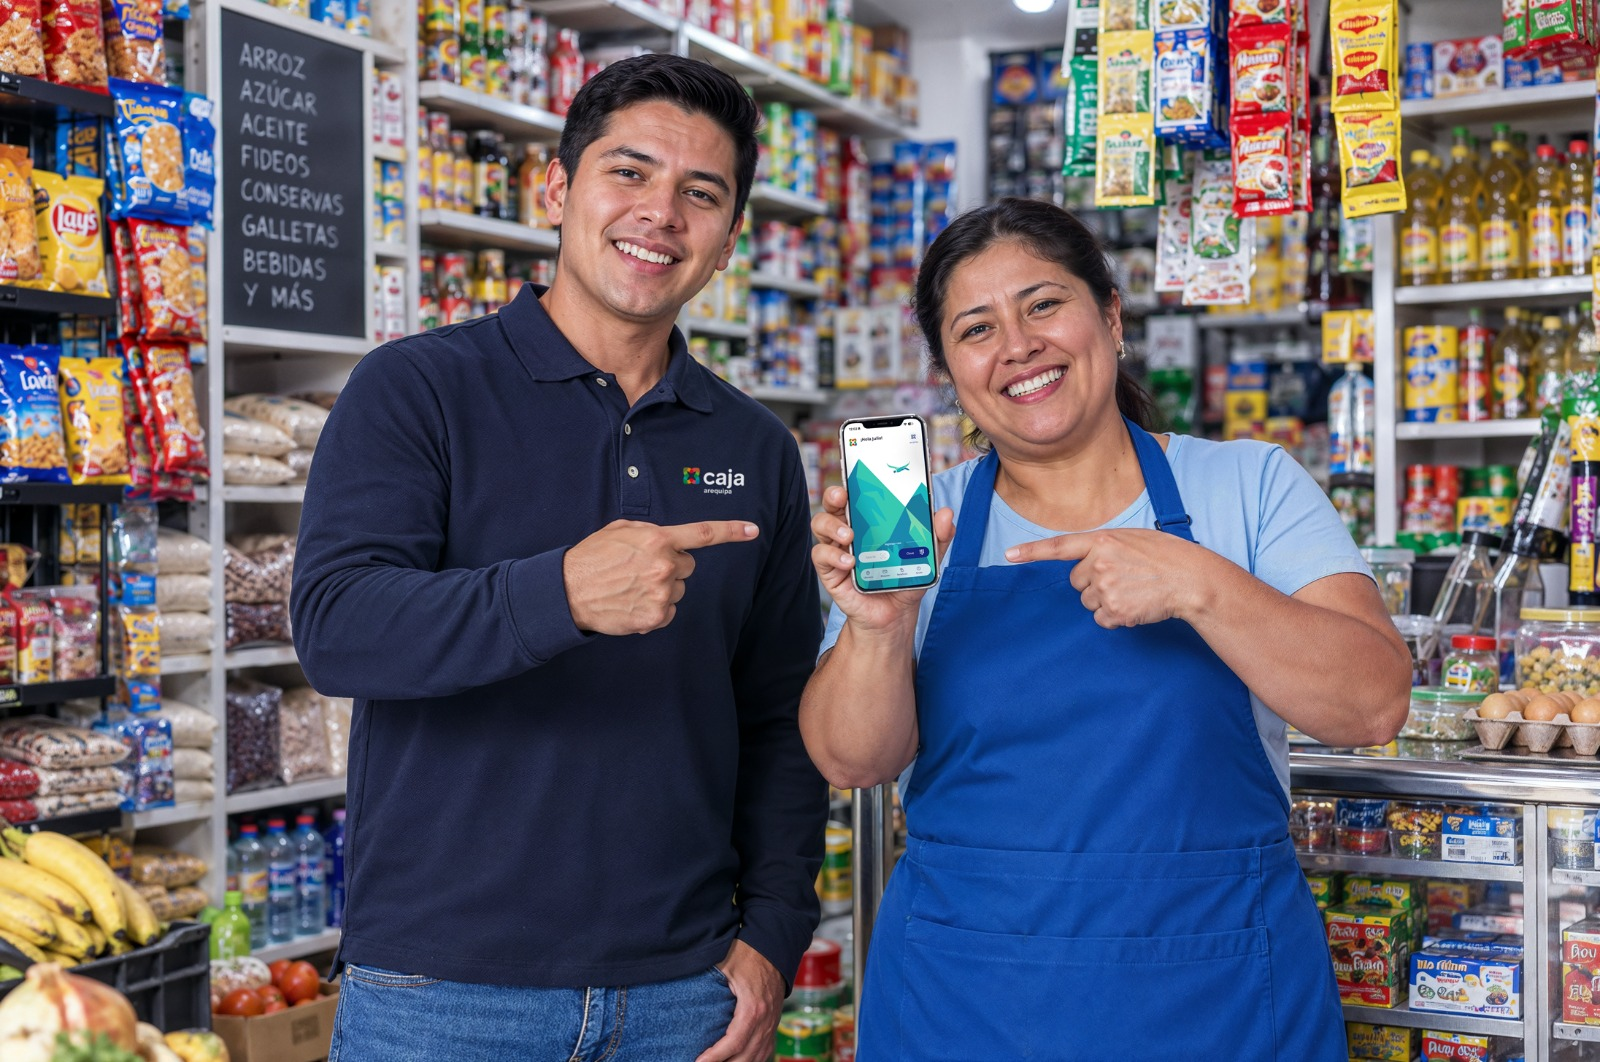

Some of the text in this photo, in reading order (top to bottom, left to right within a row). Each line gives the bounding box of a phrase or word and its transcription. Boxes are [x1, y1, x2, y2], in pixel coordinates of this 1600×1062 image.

[239, 42, 306, 80] ARROZ
[239, 79, 318, 116] AZÚCAR
[240, 112, 308, 146] ACEITE
[241, 144, 310, 178] FIDEOS
[240, 178, 344, 216] CONSERVAS
[241, 214, 339, 249] GALLETAS
[243, 248, 327, 281] BEBIDAS
[243, 281, 315, 312] Y MÁS
[703, 468, 745, 489] caja
